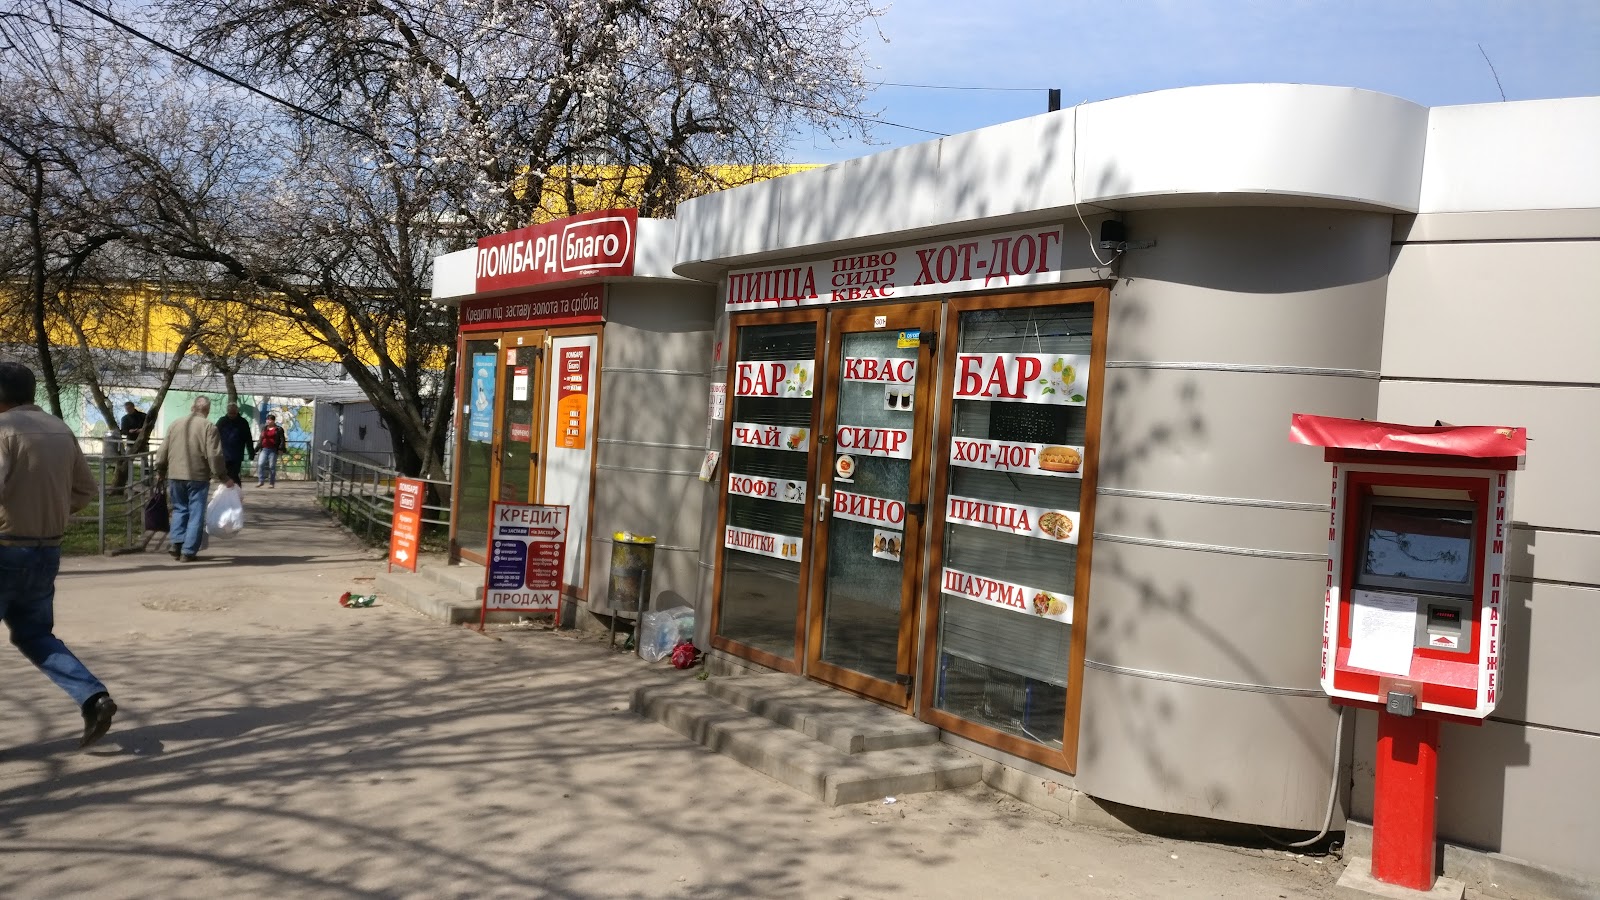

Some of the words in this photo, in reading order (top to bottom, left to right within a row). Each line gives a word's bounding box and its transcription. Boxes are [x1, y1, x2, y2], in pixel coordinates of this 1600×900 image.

[477, 234, 558, 278] ЛОМБАРД
[566, 232, 619, 260] Благо
[832, 252, 897, 272] ПИВО
[914, 230, 1060, 287] ХОТ-ДОГ
[727, 266, 818, 307] ПИЦЦА
[831, 267, 896, 287] СИДР
[831, 282, 895, 302] КВАС
[466, 306, 492, 324] Кредити
[492, 302, 502, 320] під
[505, 304, 530, 320] заставу
[532, 300, 558, 316] золота
[560, 299, 569, 312] та
[571, 292, 599, 316] срібла
[736, 363, 786, 396] БАР
[844, 359, 914, 383] КВАС
[956, 355, 1042, 400] БАР
[735, 427, 781, 447] ЧАЙ
[837, 427, 907, 455] СИДР
[953, 440, 1036, 470] ХОТ-ДОГ
[731, 477, 777, 498] КОФЕ
[1328, 466, 1338, 541] ПРИЕМ
[500, 508, 561, 524] КРЕДИТ
[833, 492, 904, 524] ВИНО
[949, 498, 1031, 533] ПИЦЦА
[1493, 474, 1506, 554] ПРИЕМ
[727, 529, 775, 553] НАПИТКИ
[493, 593, 553, 605] ПРОДАЖ
[945, 570, 1026, 610] ШАУРМА
[1320, 558, 1333, 680] ПЛАТЕЖЕЙ
[1486, 573, 1500, 704] ПЛАТЕЖЕЙ
